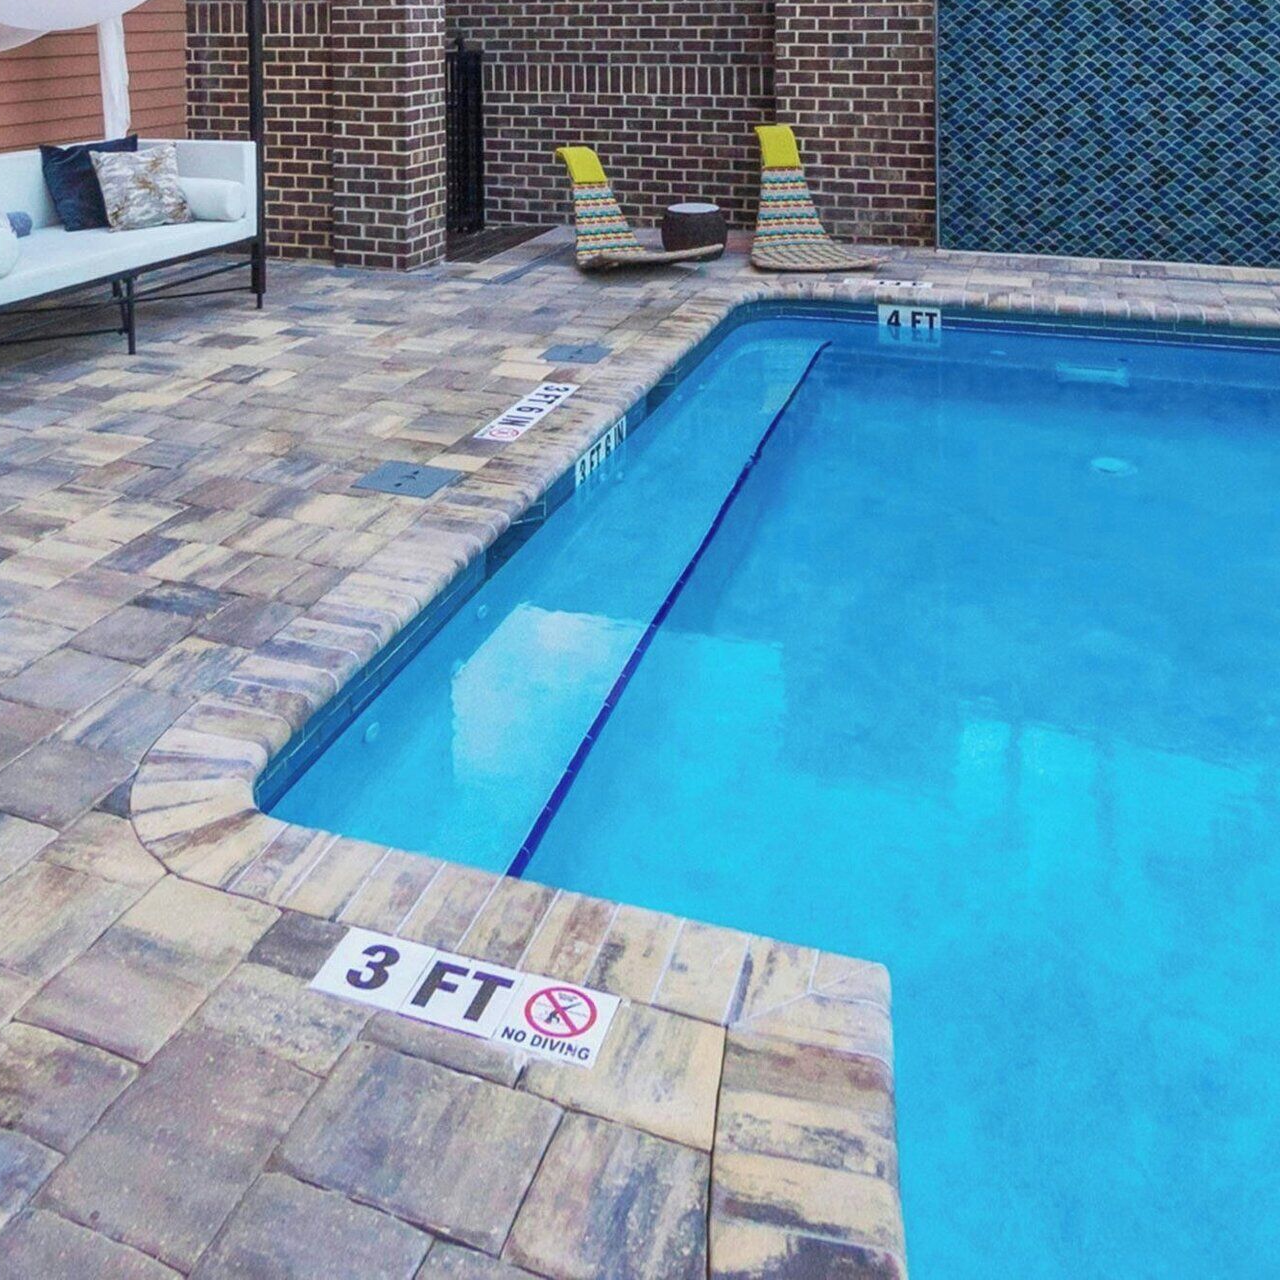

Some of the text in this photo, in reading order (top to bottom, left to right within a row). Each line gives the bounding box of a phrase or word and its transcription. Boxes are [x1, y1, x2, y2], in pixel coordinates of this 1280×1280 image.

[887, 310, 937, 329] 4 FT
[345, 944, 515, 1023] 3 FT
[500, 1026, 591, 1062] NO DIVING
